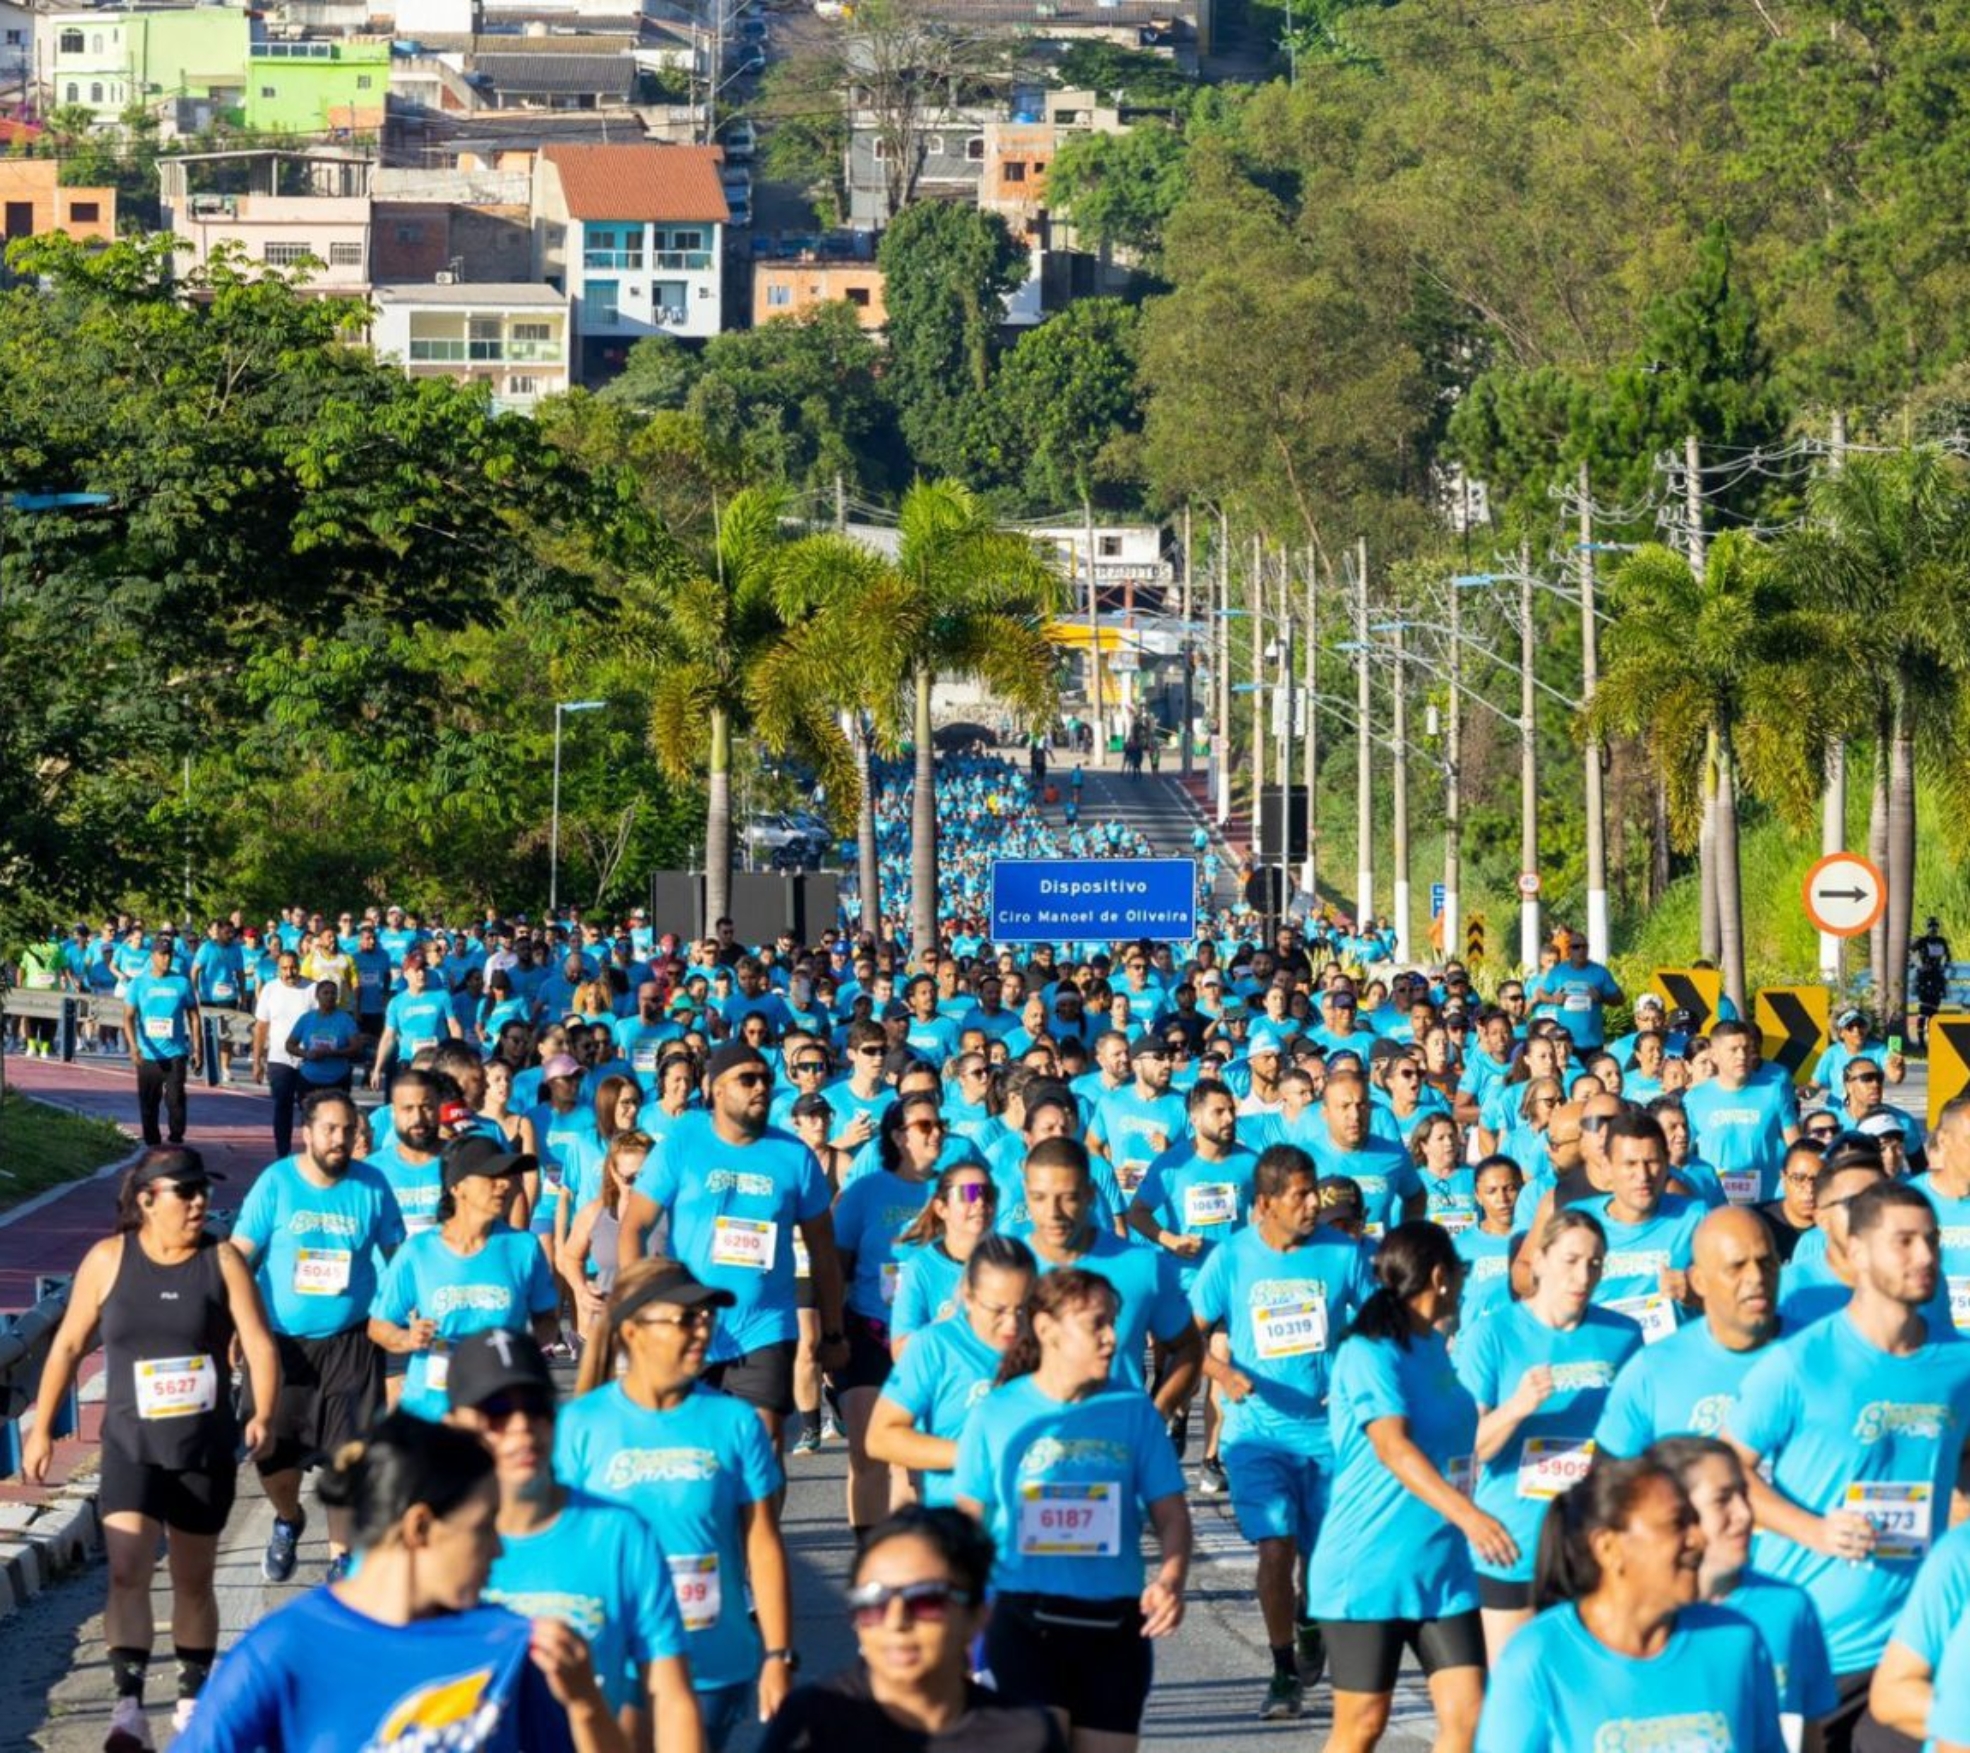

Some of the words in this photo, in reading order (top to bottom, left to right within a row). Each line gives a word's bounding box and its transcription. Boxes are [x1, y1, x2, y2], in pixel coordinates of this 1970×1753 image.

[1040, 879, 1148, 897] Dispositivo
[998, 910, 1032, 924] Ciro
[1038, 910, 1095, 923] Manoel
[1100, 910, 1119, 923] de
[1126, 908, 1188, 923] Oliveira
[1266, 1319, 1313, 1338] 10319
[153, 1377, 198, 1397] 5627
[1040, 1508, 1094, 1529] 6187
